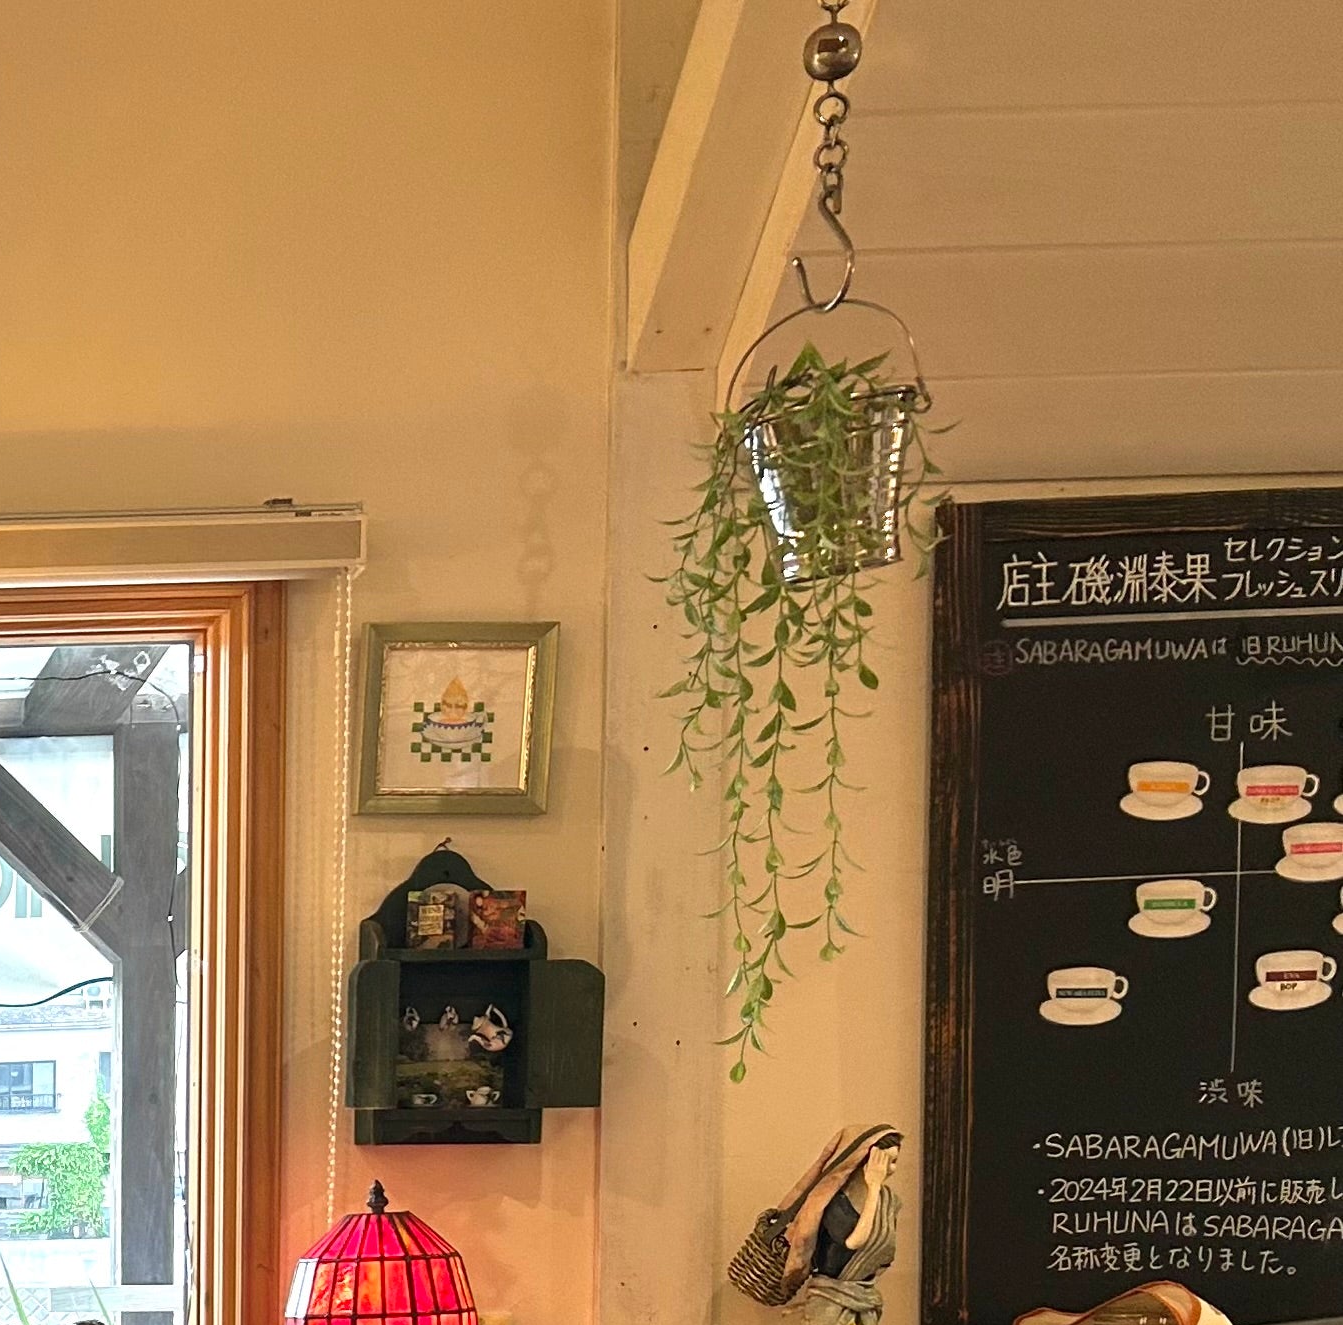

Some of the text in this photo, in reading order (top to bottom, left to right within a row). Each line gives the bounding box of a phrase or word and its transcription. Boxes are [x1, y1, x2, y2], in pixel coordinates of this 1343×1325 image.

[1223, 535, 1343, 564] セレクション
[997, 550, 1217, 611] 店主磯淵泰果
[1221, 567, 1343, 601] フレッシュスリ
[982, 869, 1015, 901] 明
[1046, 1243, 1298, 1275] 名称変更となりました。
